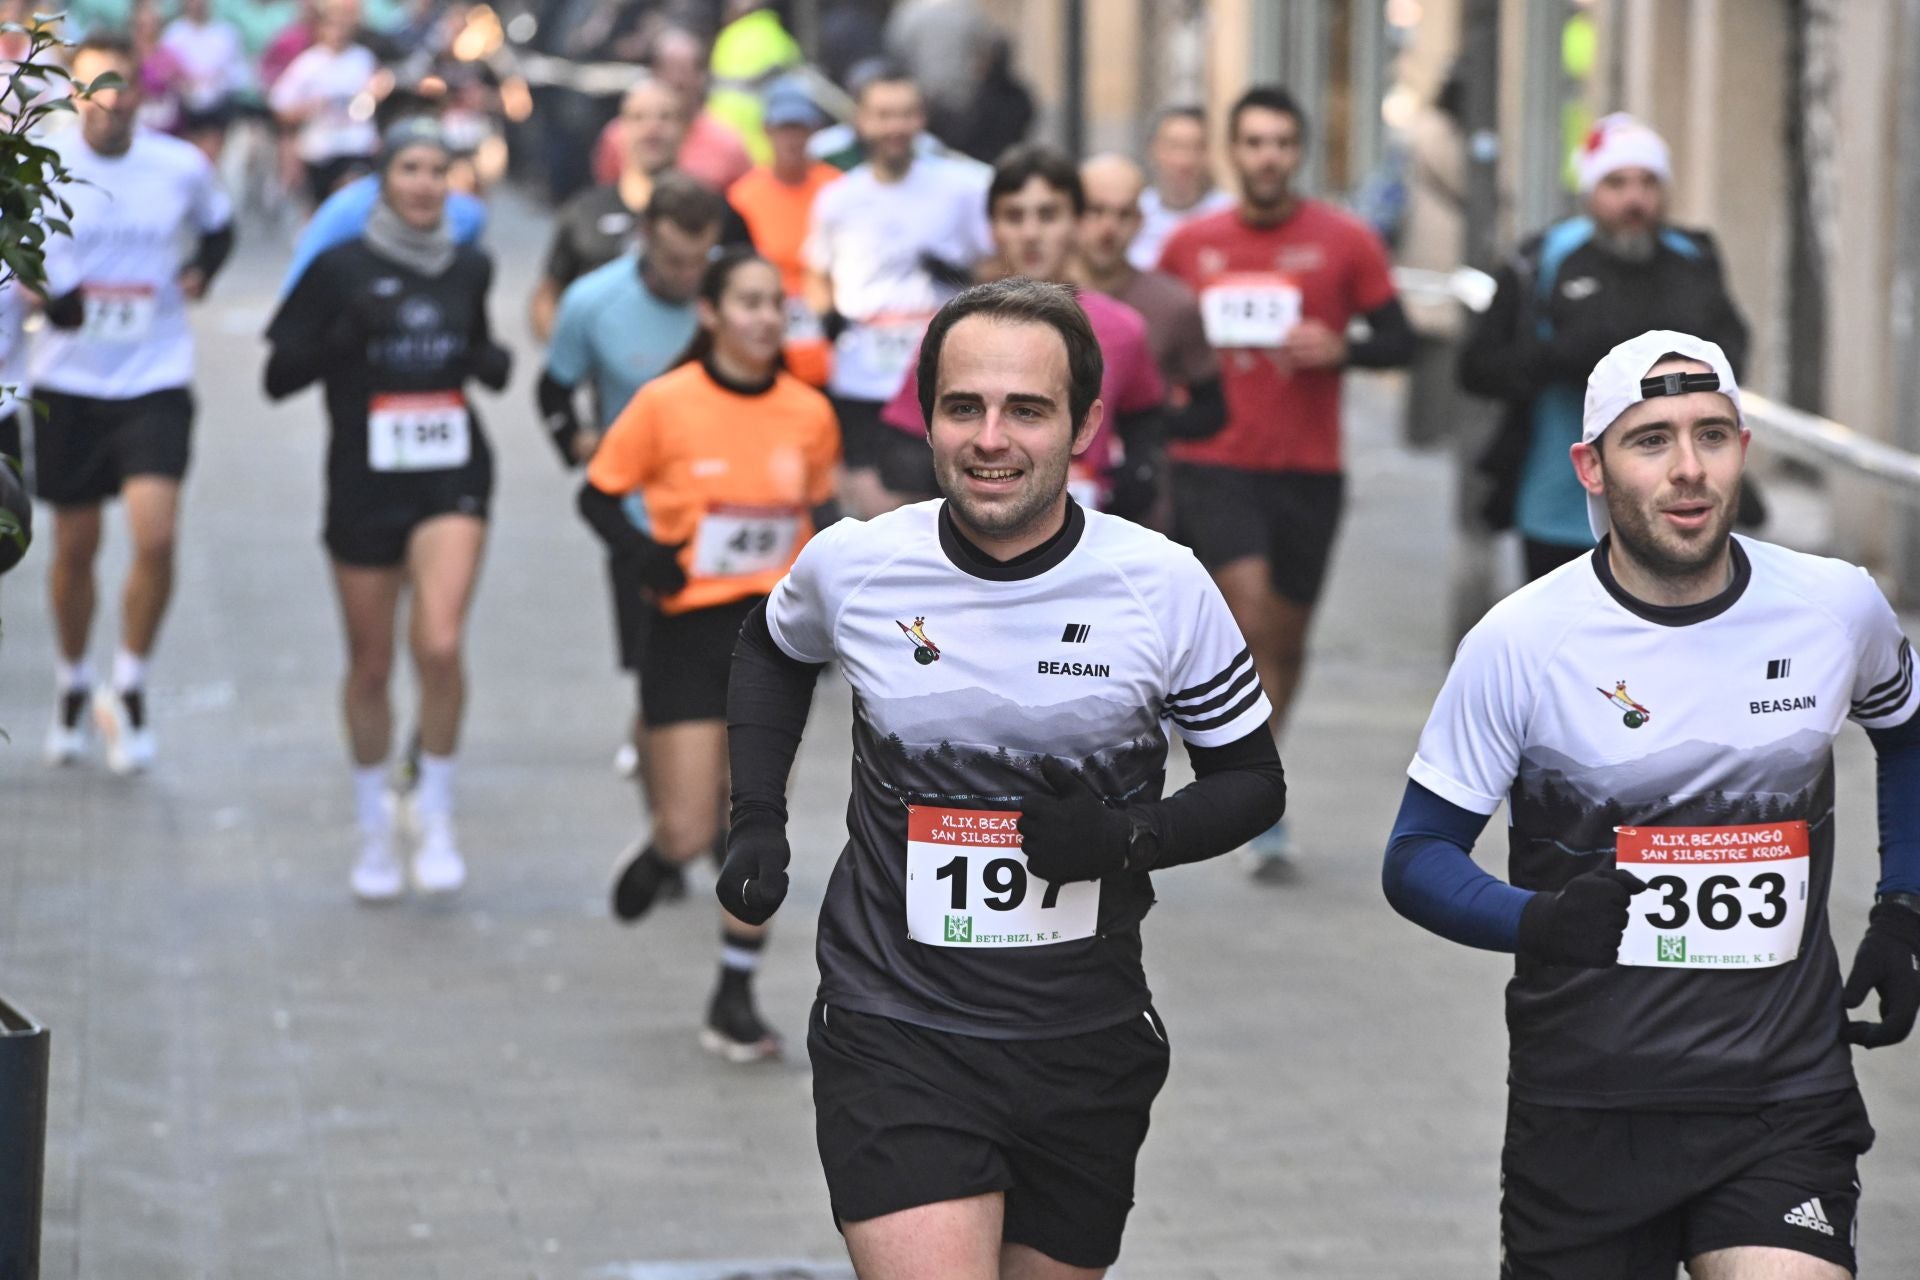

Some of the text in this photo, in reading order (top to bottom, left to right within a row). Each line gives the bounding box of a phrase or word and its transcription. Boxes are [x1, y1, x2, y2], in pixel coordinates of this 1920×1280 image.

[727, 526, 777, 555] 49
[1037, 660, 1110, 678] BEASAIN
[1749, 694, 1818, 714] BEASAIN
[931, 829, 1024, 844] SAN SILBESTR
[1641, 845, 1792, 861] SAN SILBESTRE KROSA
[1644, 872, 1788, 931] 363
[975, 934, 1033, 944] BETI-BIZI,
[1783, 1212, 1836, 1237] adidas
